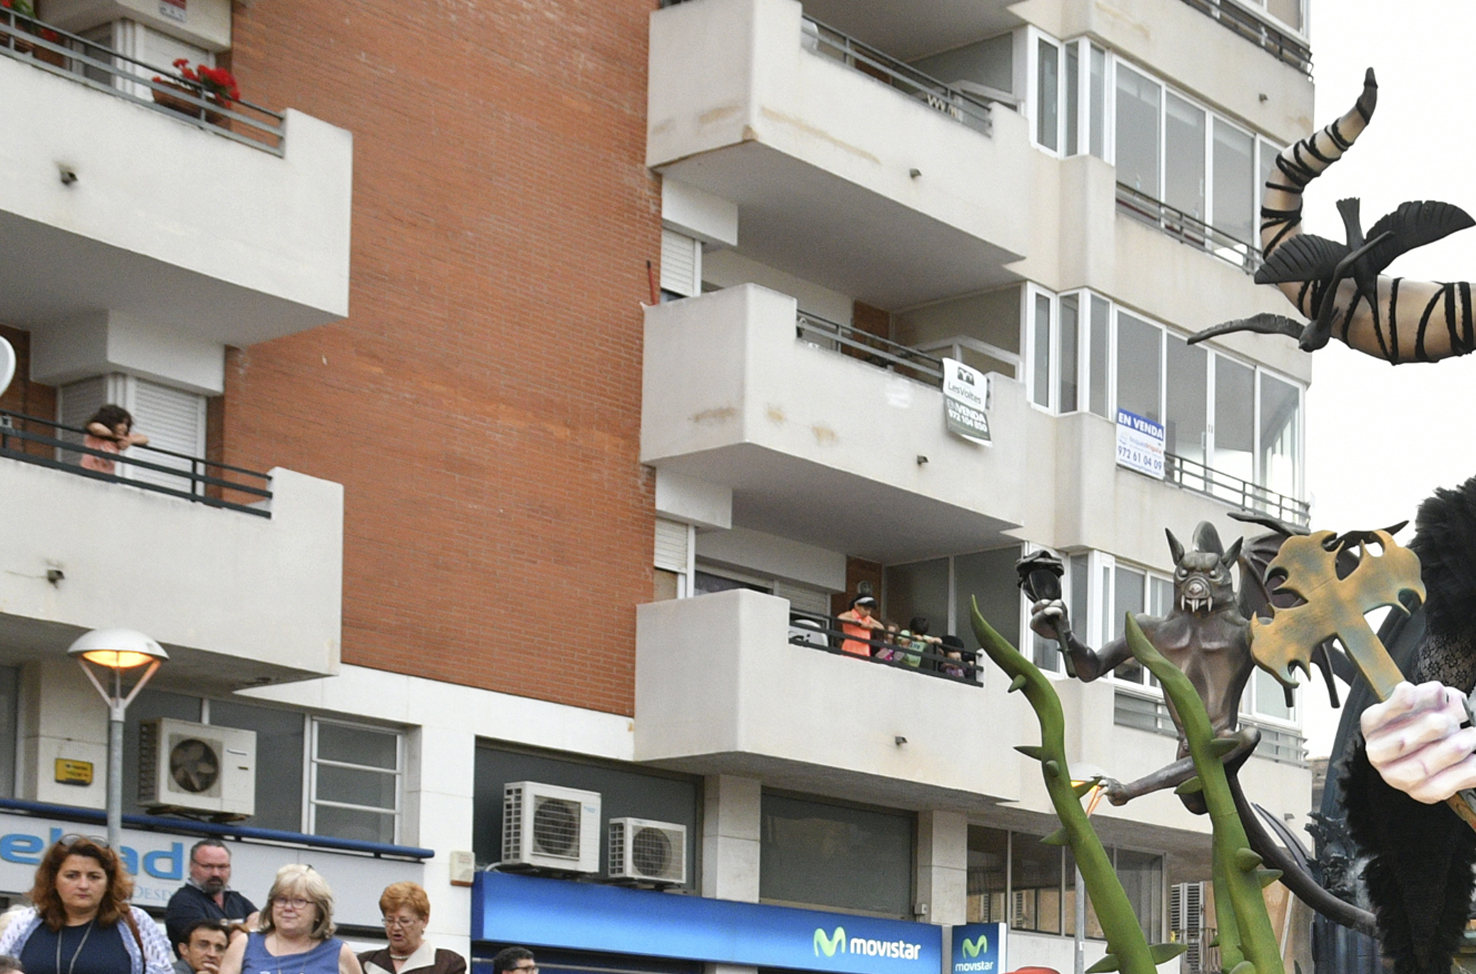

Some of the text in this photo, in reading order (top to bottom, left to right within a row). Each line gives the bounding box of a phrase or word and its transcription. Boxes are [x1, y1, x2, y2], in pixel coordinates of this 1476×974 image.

[1118, 412, 1164, 439] EN VENDA
[1117, 445, 1131, 459] 972
[1133, 451, 1141, 463] 61
[1143, 455, 1152, 466] 04
[1154, 459, 1162, 470] 09
[850, 937, 922, 960] movistar
[955, 961, 994, 973] movistar
